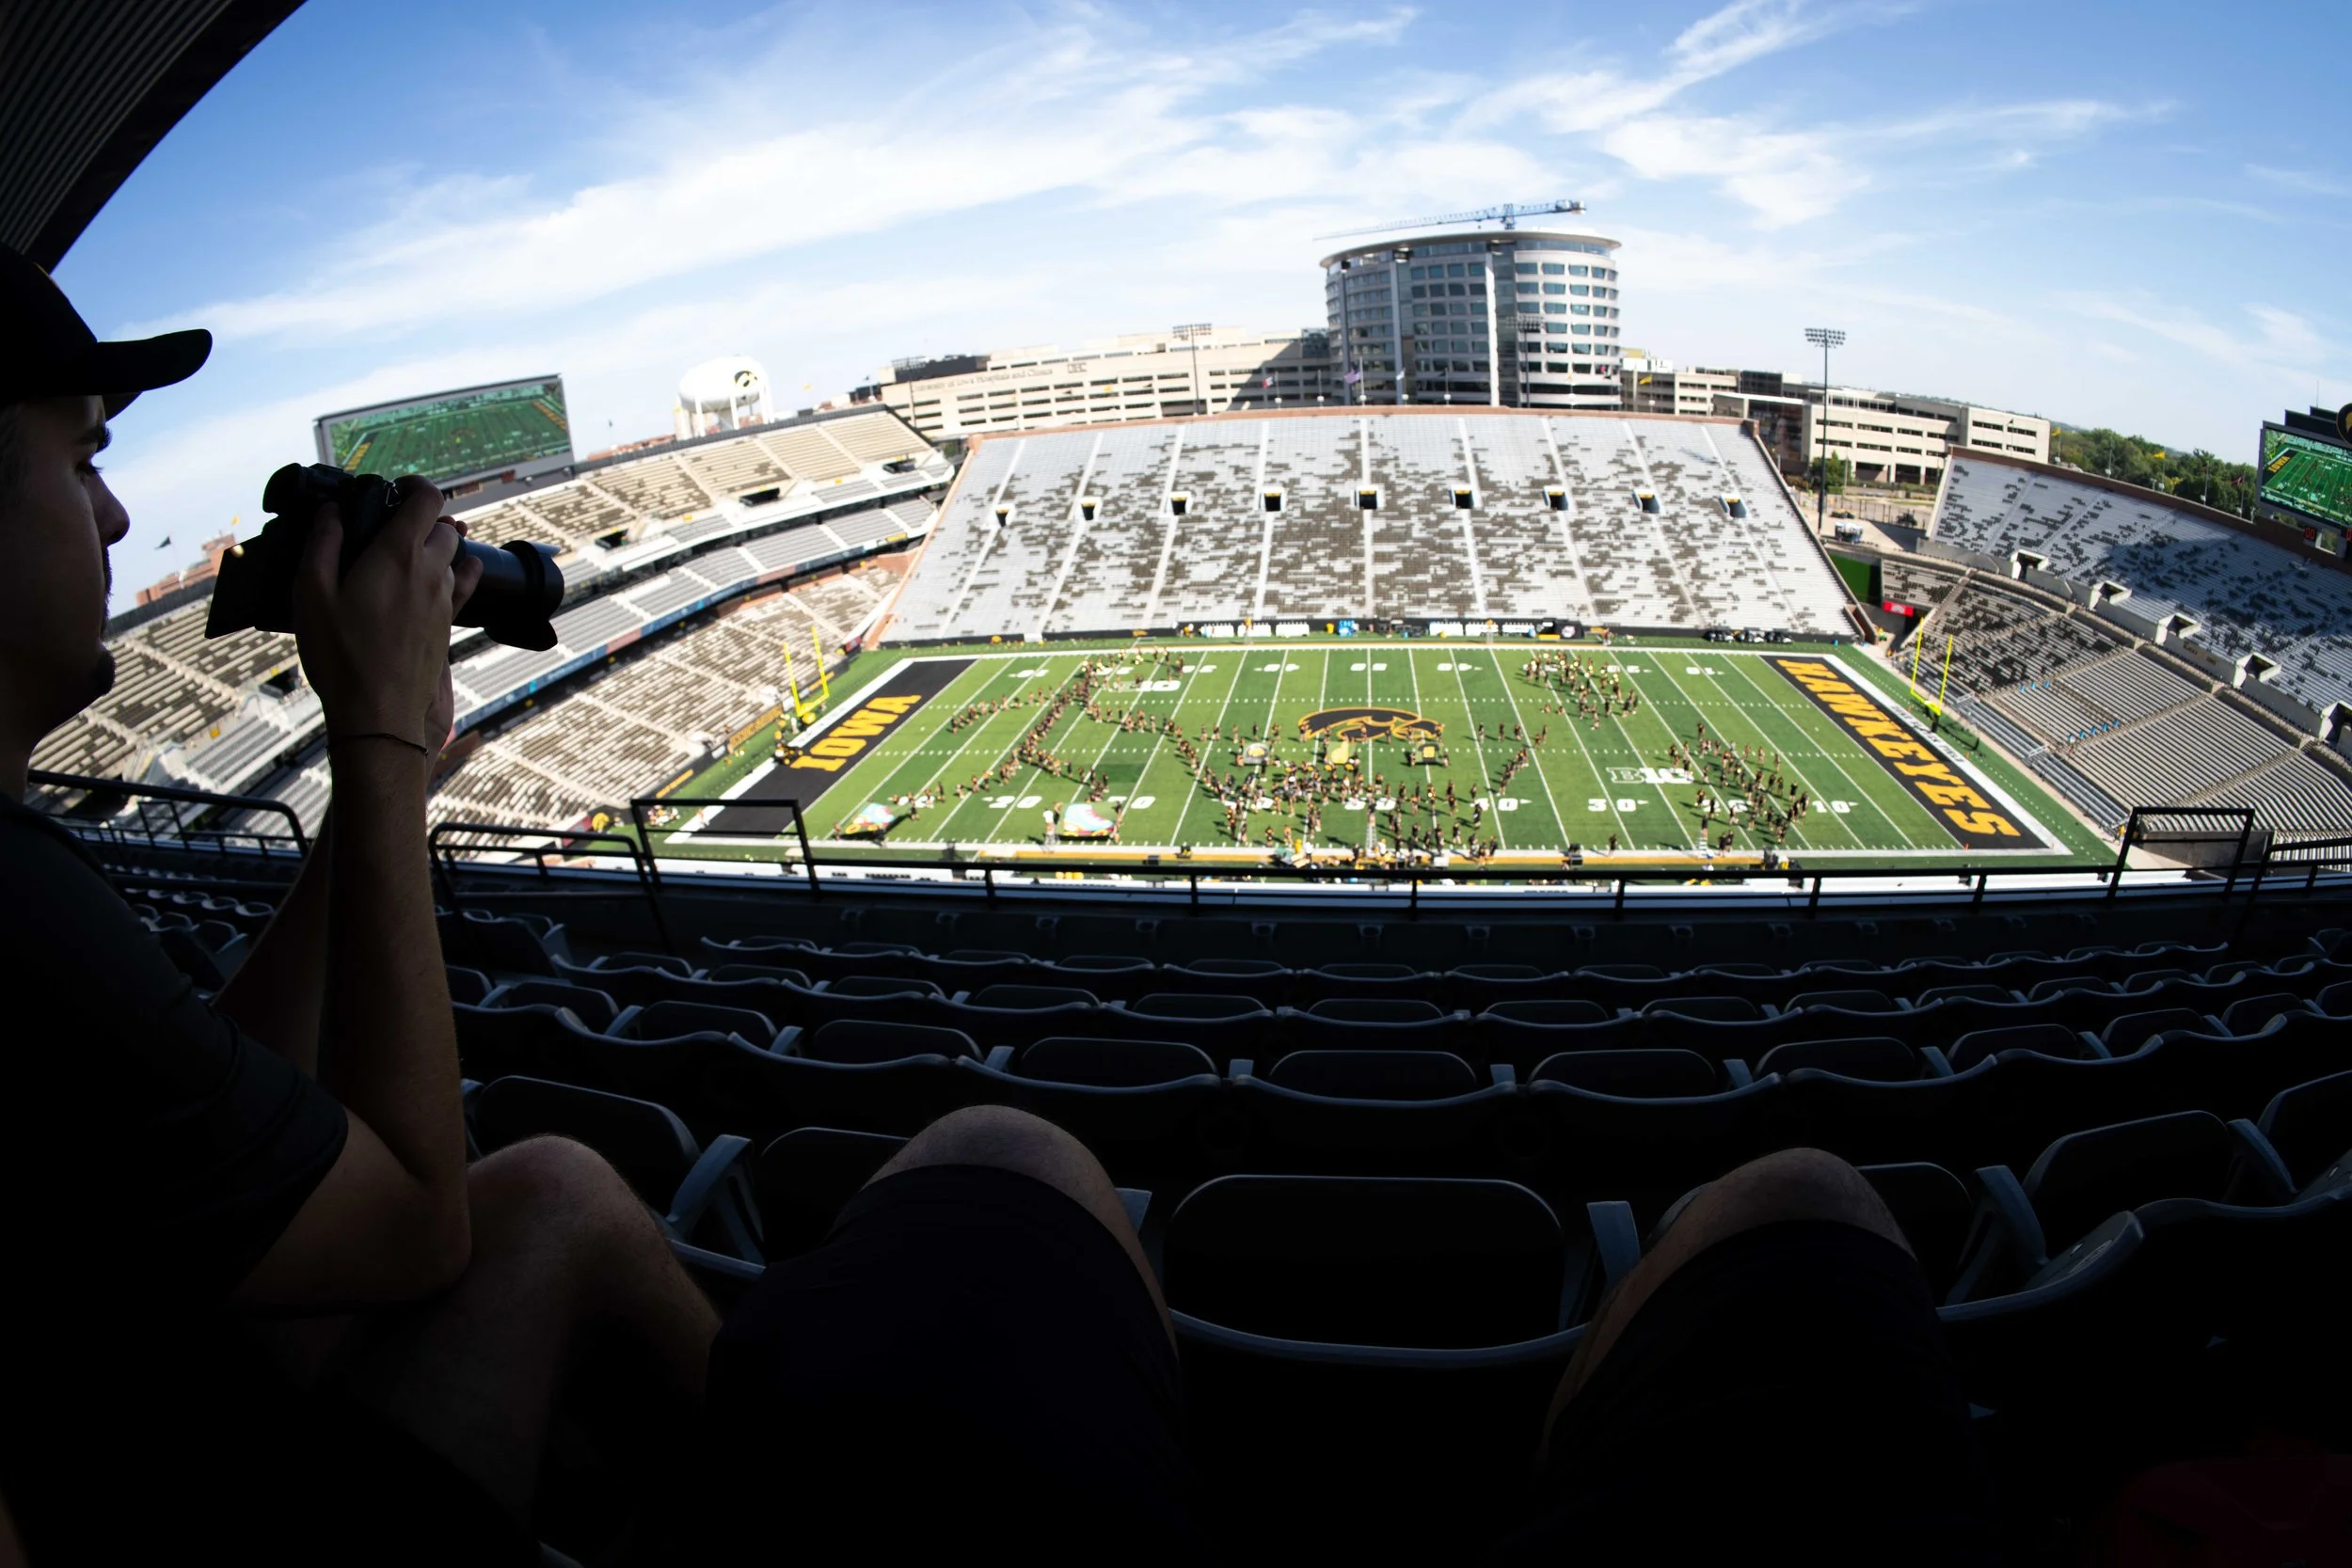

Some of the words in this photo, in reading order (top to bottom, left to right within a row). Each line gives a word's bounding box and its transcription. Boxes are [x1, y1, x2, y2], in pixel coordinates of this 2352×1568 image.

[2267, 455, 2291, 473] IOWA
[789, 693, 923, 772] IOWA
[1776, 659, 2022, 837] HAWKEYES
[989, 796, 1042, 809] 20
[1588, 799, 1637, 812] 30
[1812, 800, 1851, 814] 10
